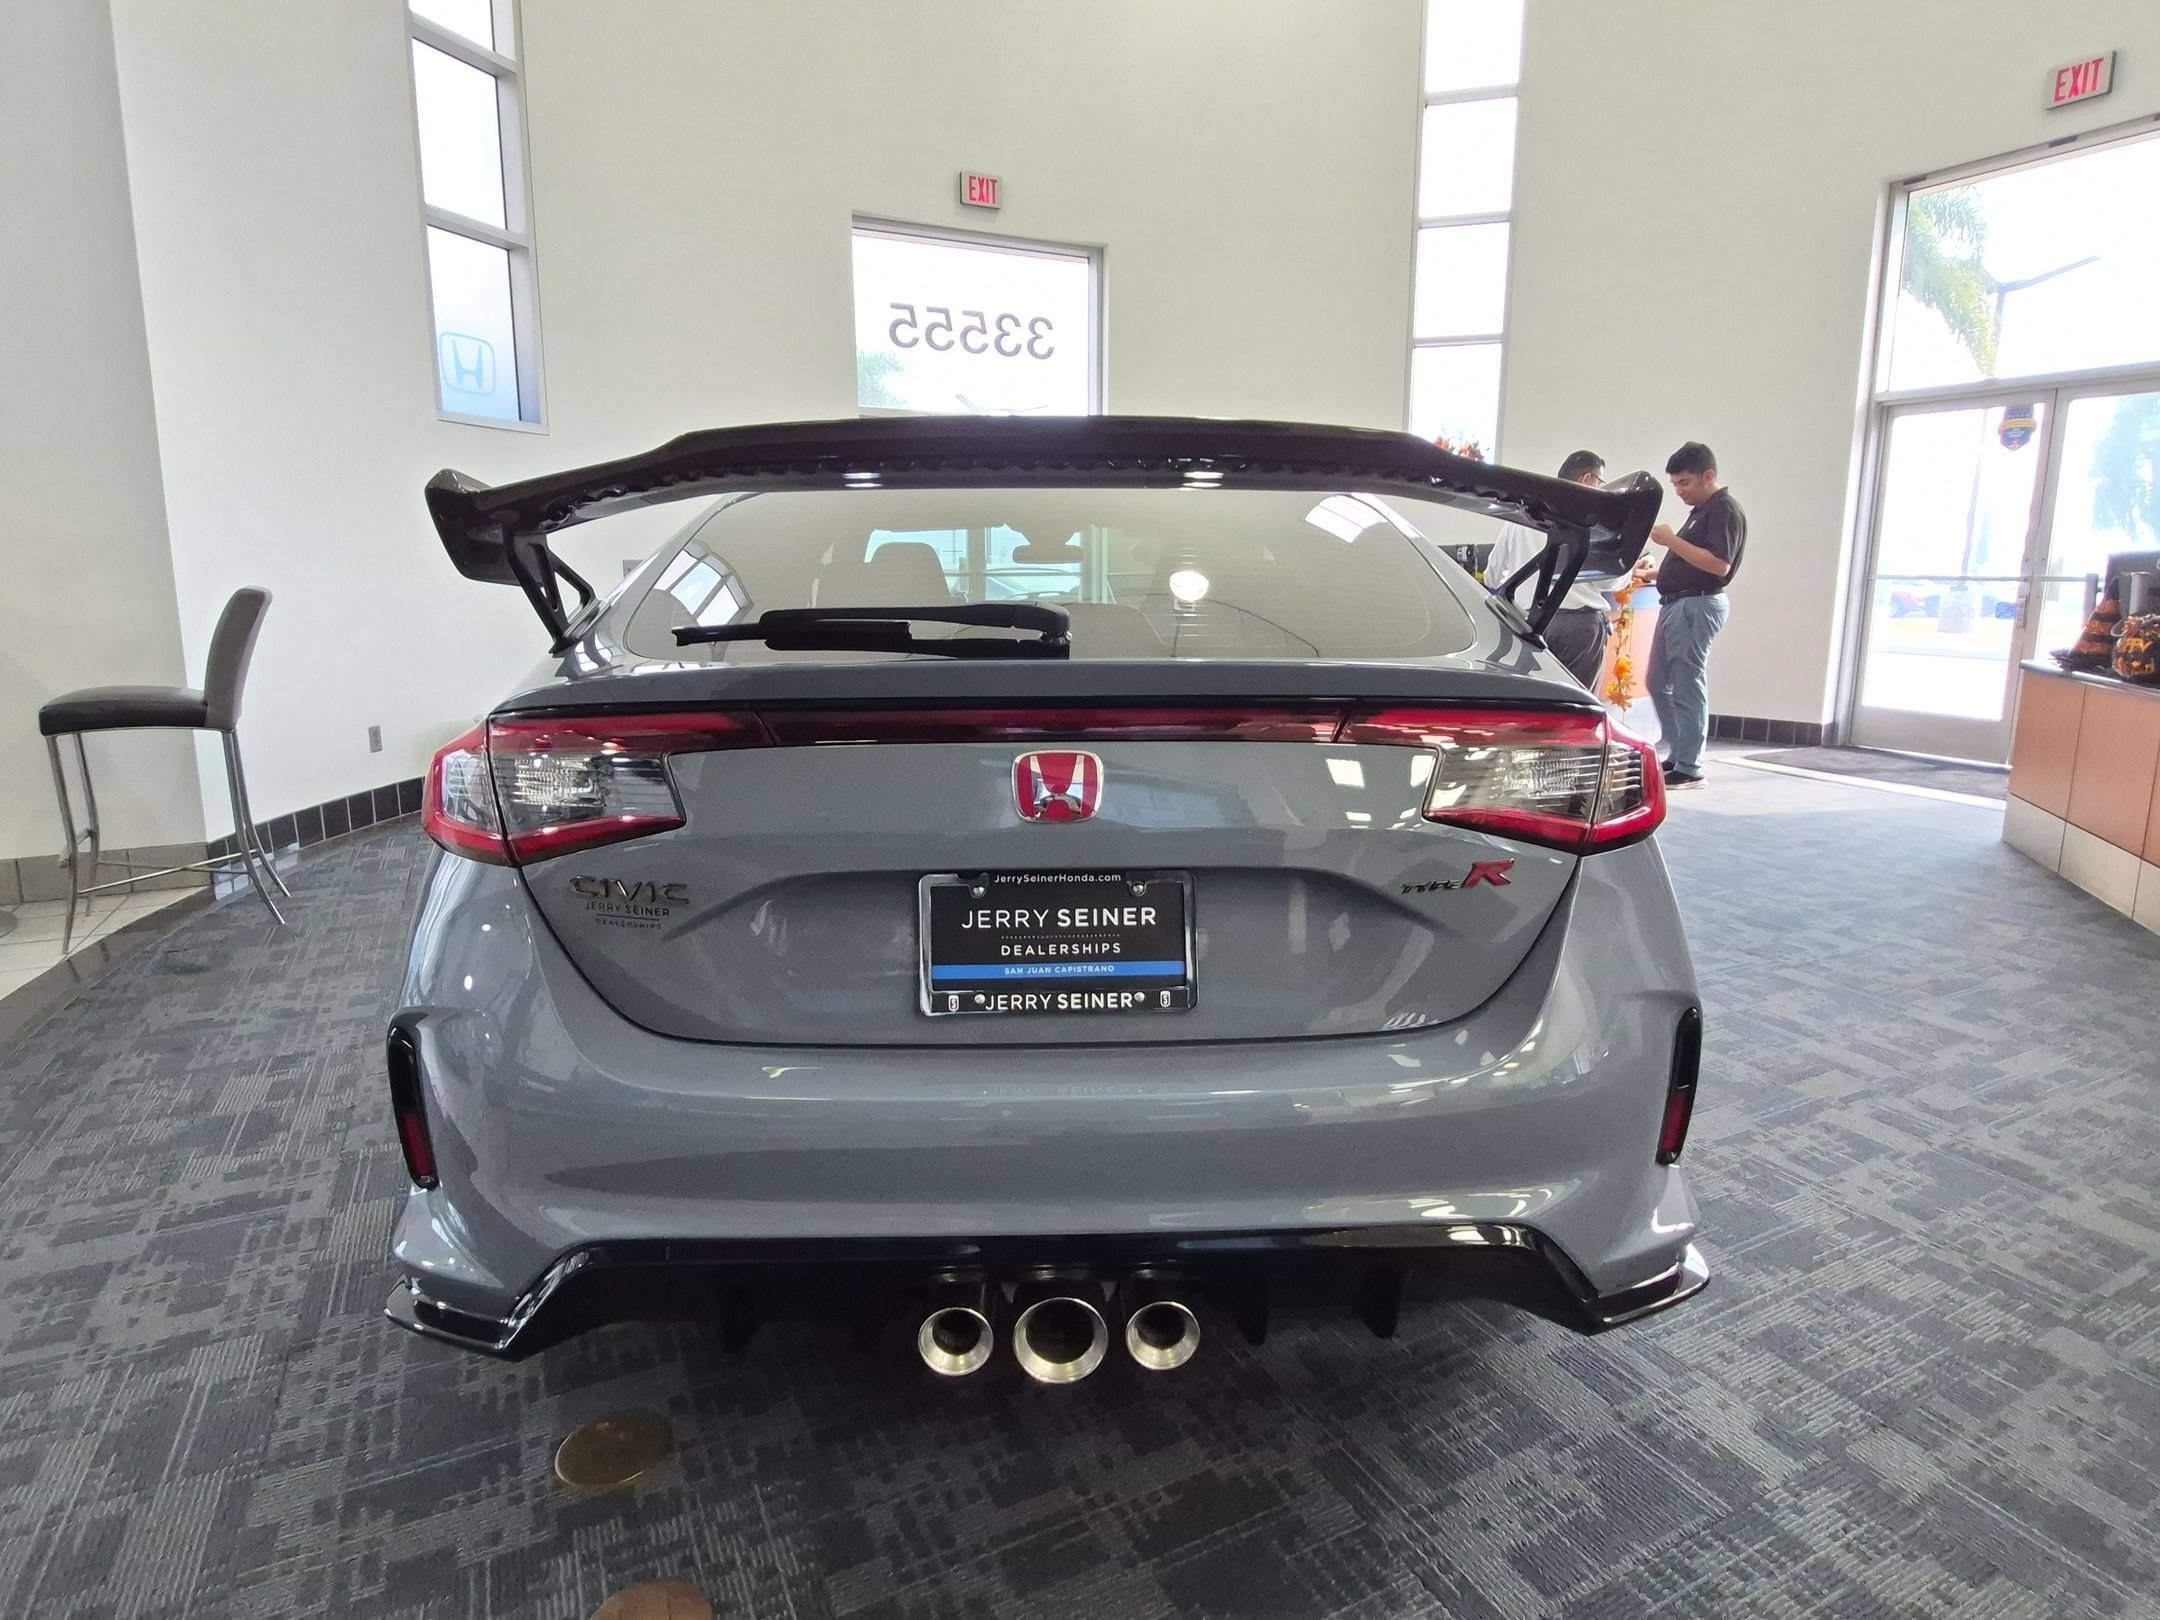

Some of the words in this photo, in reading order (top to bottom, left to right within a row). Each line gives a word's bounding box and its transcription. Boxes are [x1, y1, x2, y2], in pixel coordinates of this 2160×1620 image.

[2054, 57, 2104, 102] EXIT
[968, 175, 998, 204] EXIT
[994, 873, 1121, 884] JerrySeinerHonda.com
[1460, 858, 1514, 888] R
[569, 874, 690, 905] CIVIC
[585, 901, 621, 912] JERRY
[625, 905, 670, 917] SEINER
[962, 909, 1049, 929] JERRY
[1057, 907, 1156, 926] SEINER
[1001, 942, 1121, 956] DEALERSHIPS
[1004, 966, 1023, 975] SAN
[1027, 966, 1051, 974] JUAN
[1055, 965, 1115, 974] CAPISTRANO
[985, 993, 1051, 1010] JERRY
[1057, 992, 1133, 1009] SEINER
